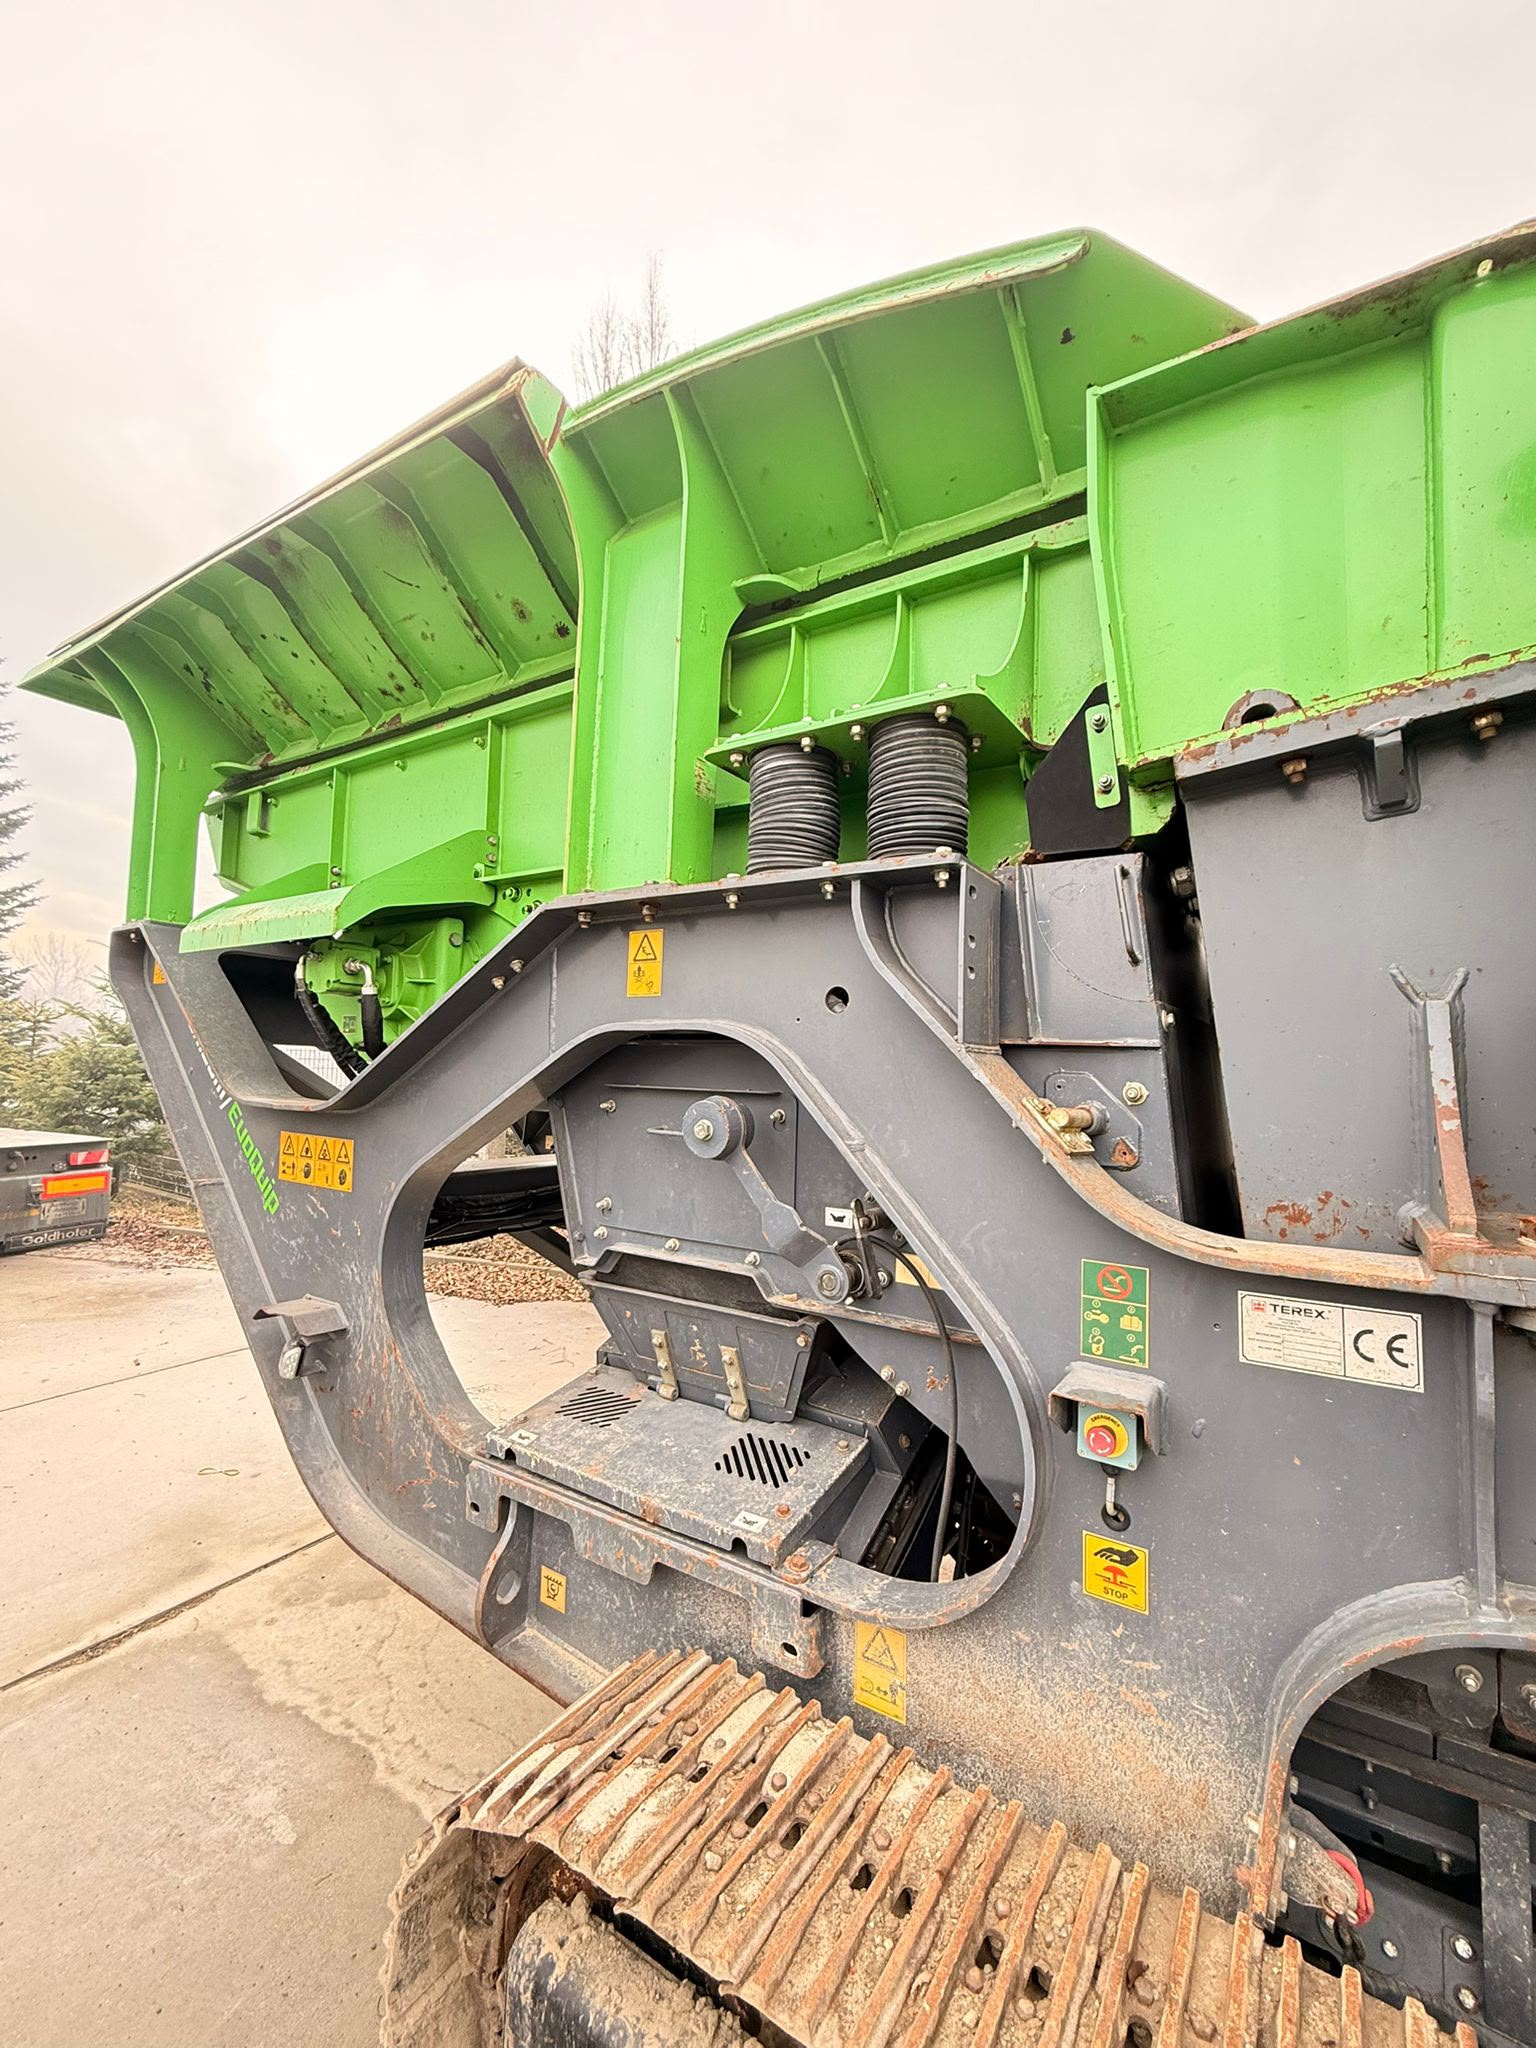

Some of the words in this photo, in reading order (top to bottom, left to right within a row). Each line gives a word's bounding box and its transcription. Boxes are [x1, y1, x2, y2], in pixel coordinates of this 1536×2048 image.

[1269, 1303, 1326, 1320] TEREX
[1353, 1329, 1409, 1369] CE
[1090, 1414, 1120, 1428] EMERGENCY
[1103, 1586, 1128, 1600] STOP
